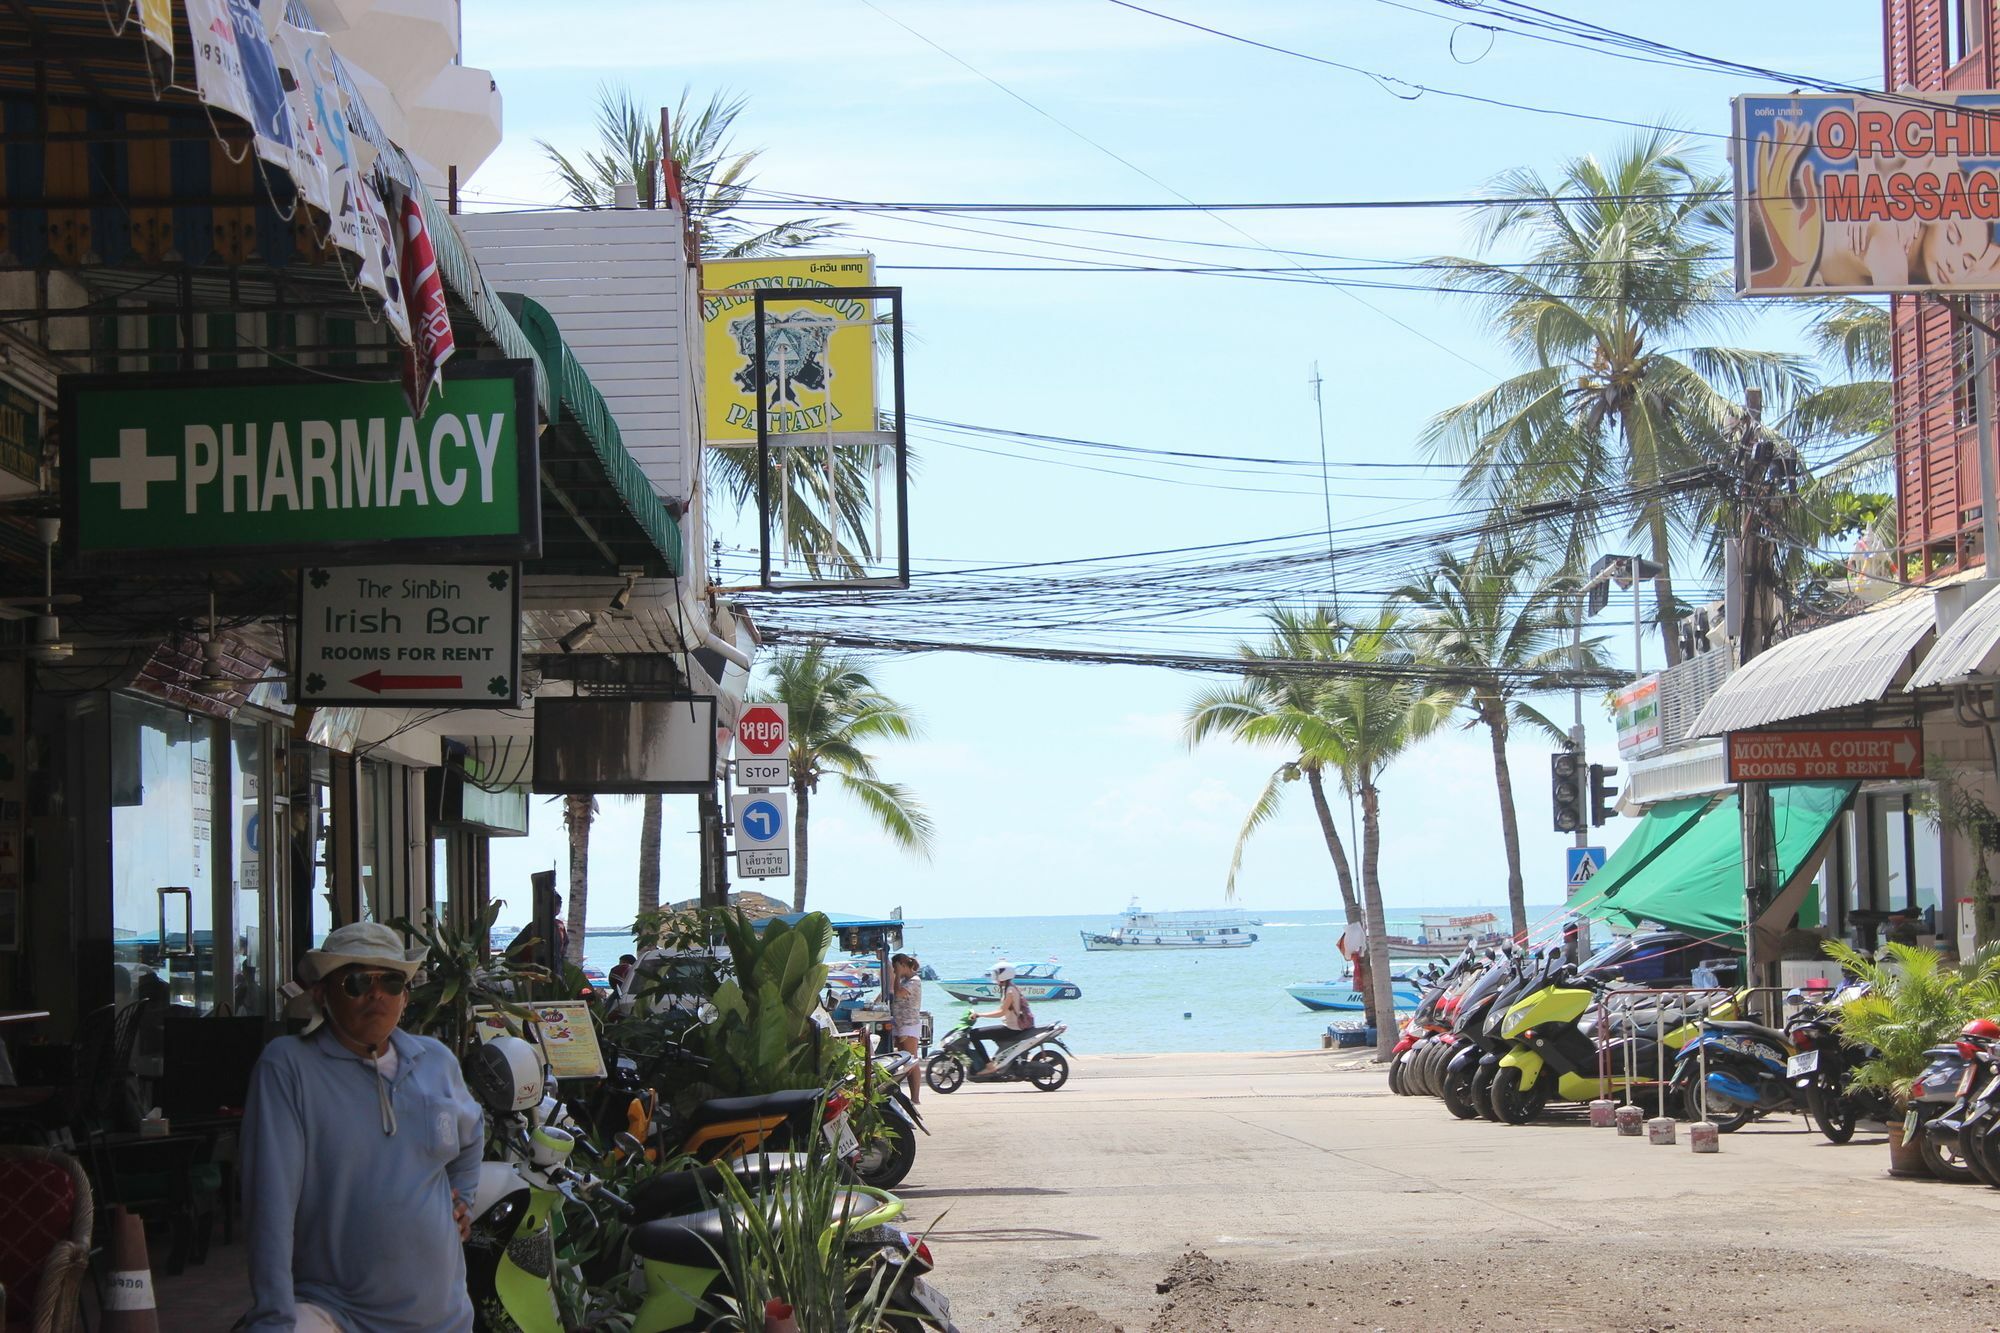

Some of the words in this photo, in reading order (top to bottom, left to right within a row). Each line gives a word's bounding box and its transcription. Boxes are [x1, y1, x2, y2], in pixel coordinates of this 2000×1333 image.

[1816, 109, 2000, 160] ORCHI
[1823, 171, 2000, 222] MASSAG
[725, 403, 842, 433] PATTAYA
[185, 412, 505, 514] PHARMACY
[357, 578, 393, 599] The
[401, 578, 460, 599] SinBin
[325, 606, 401, 634] Irish
[426, 607, 490, 635] Bar
[321, 646, 391, 661] ROOMS
[397, 647, 436, 661] FOR
[442, 647, 494, 661] RENT
[740, 721, 784, 748] หยุด
[1734, 740, 1824, 760] MONTANA
[1829, 740, 1892, 758] COURT
[745, 767, 780, 778] STOP
[1738, 762, 1797, 777] ROOMS
[1804, 761, 1839, 776] FOR
[1845, 760, 1890, 775] RENT
[746, 865, 766, 875] Turn
[768, 864, 783, 874] left
